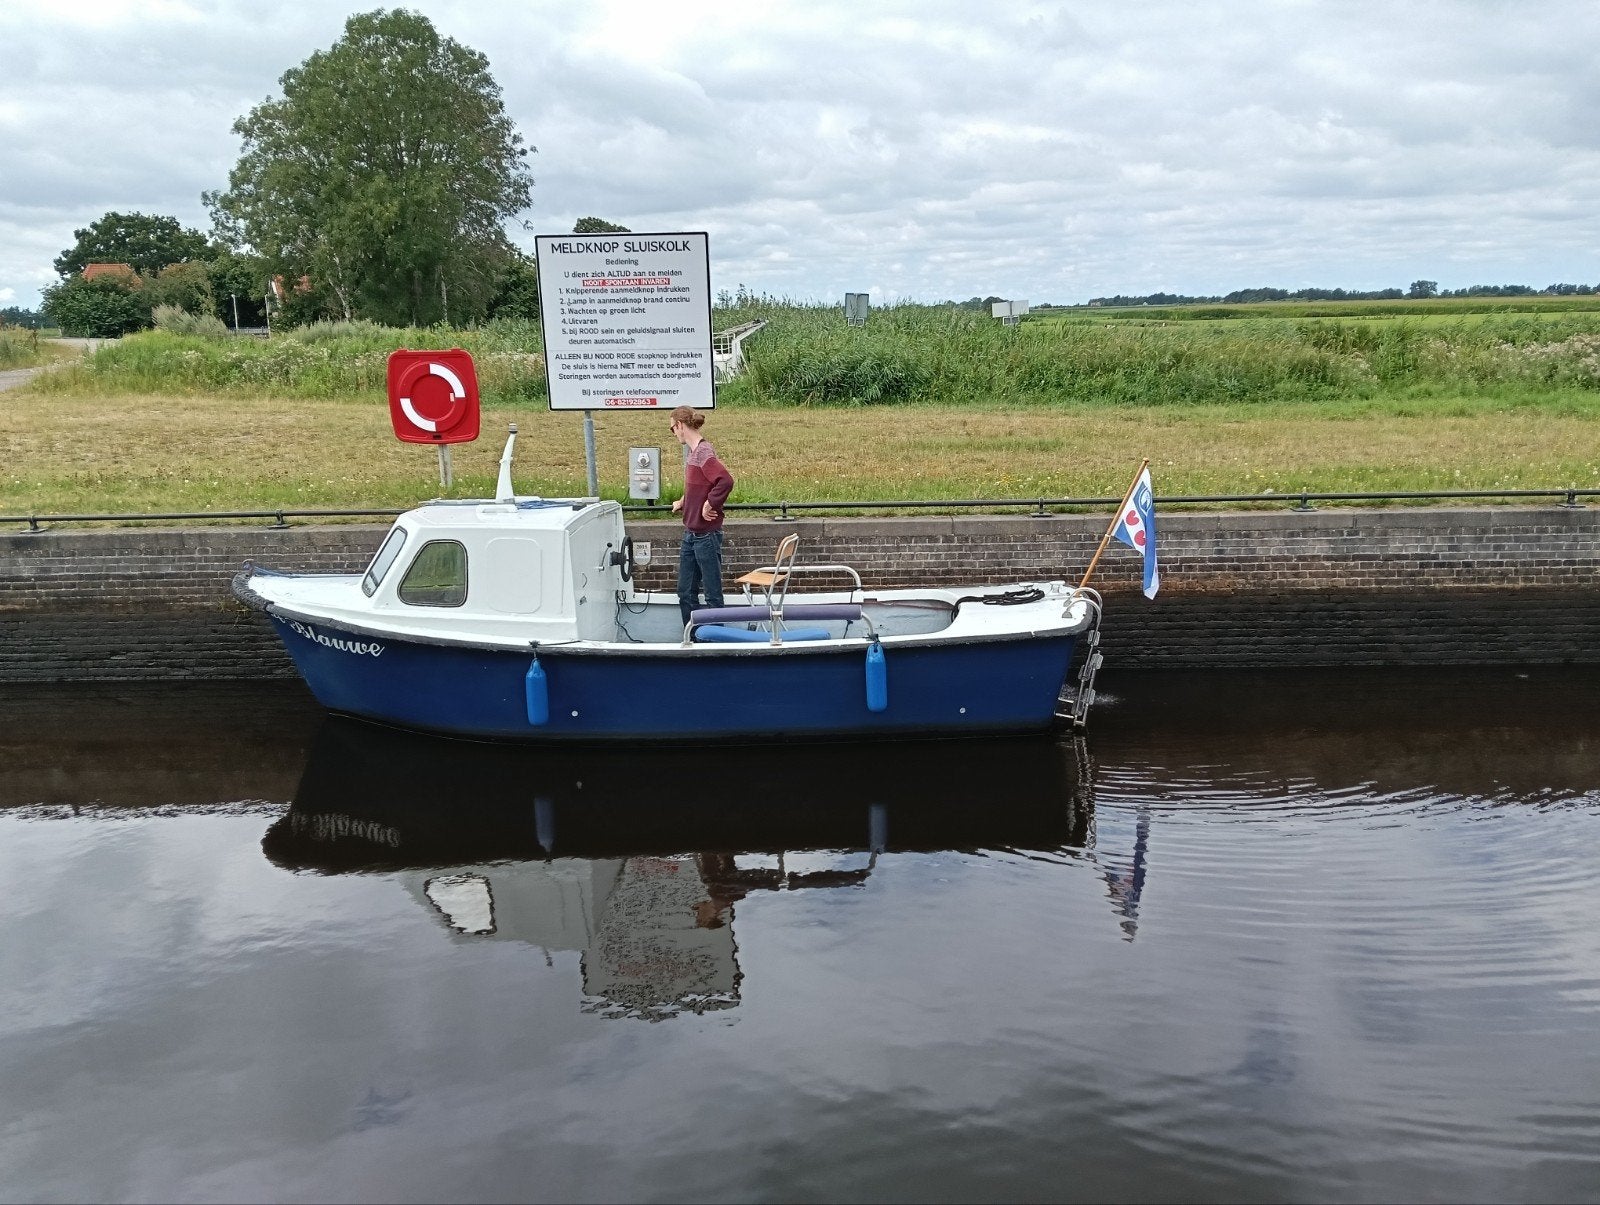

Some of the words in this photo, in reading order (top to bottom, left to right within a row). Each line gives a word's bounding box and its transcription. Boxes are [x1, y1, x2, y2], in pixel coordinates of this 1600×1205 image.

[551, 242, 619, 254] MELDKNOP
[624, 240, 691, 252] SLUISKOLK
[290, 621, 385, 657] Blauwe
